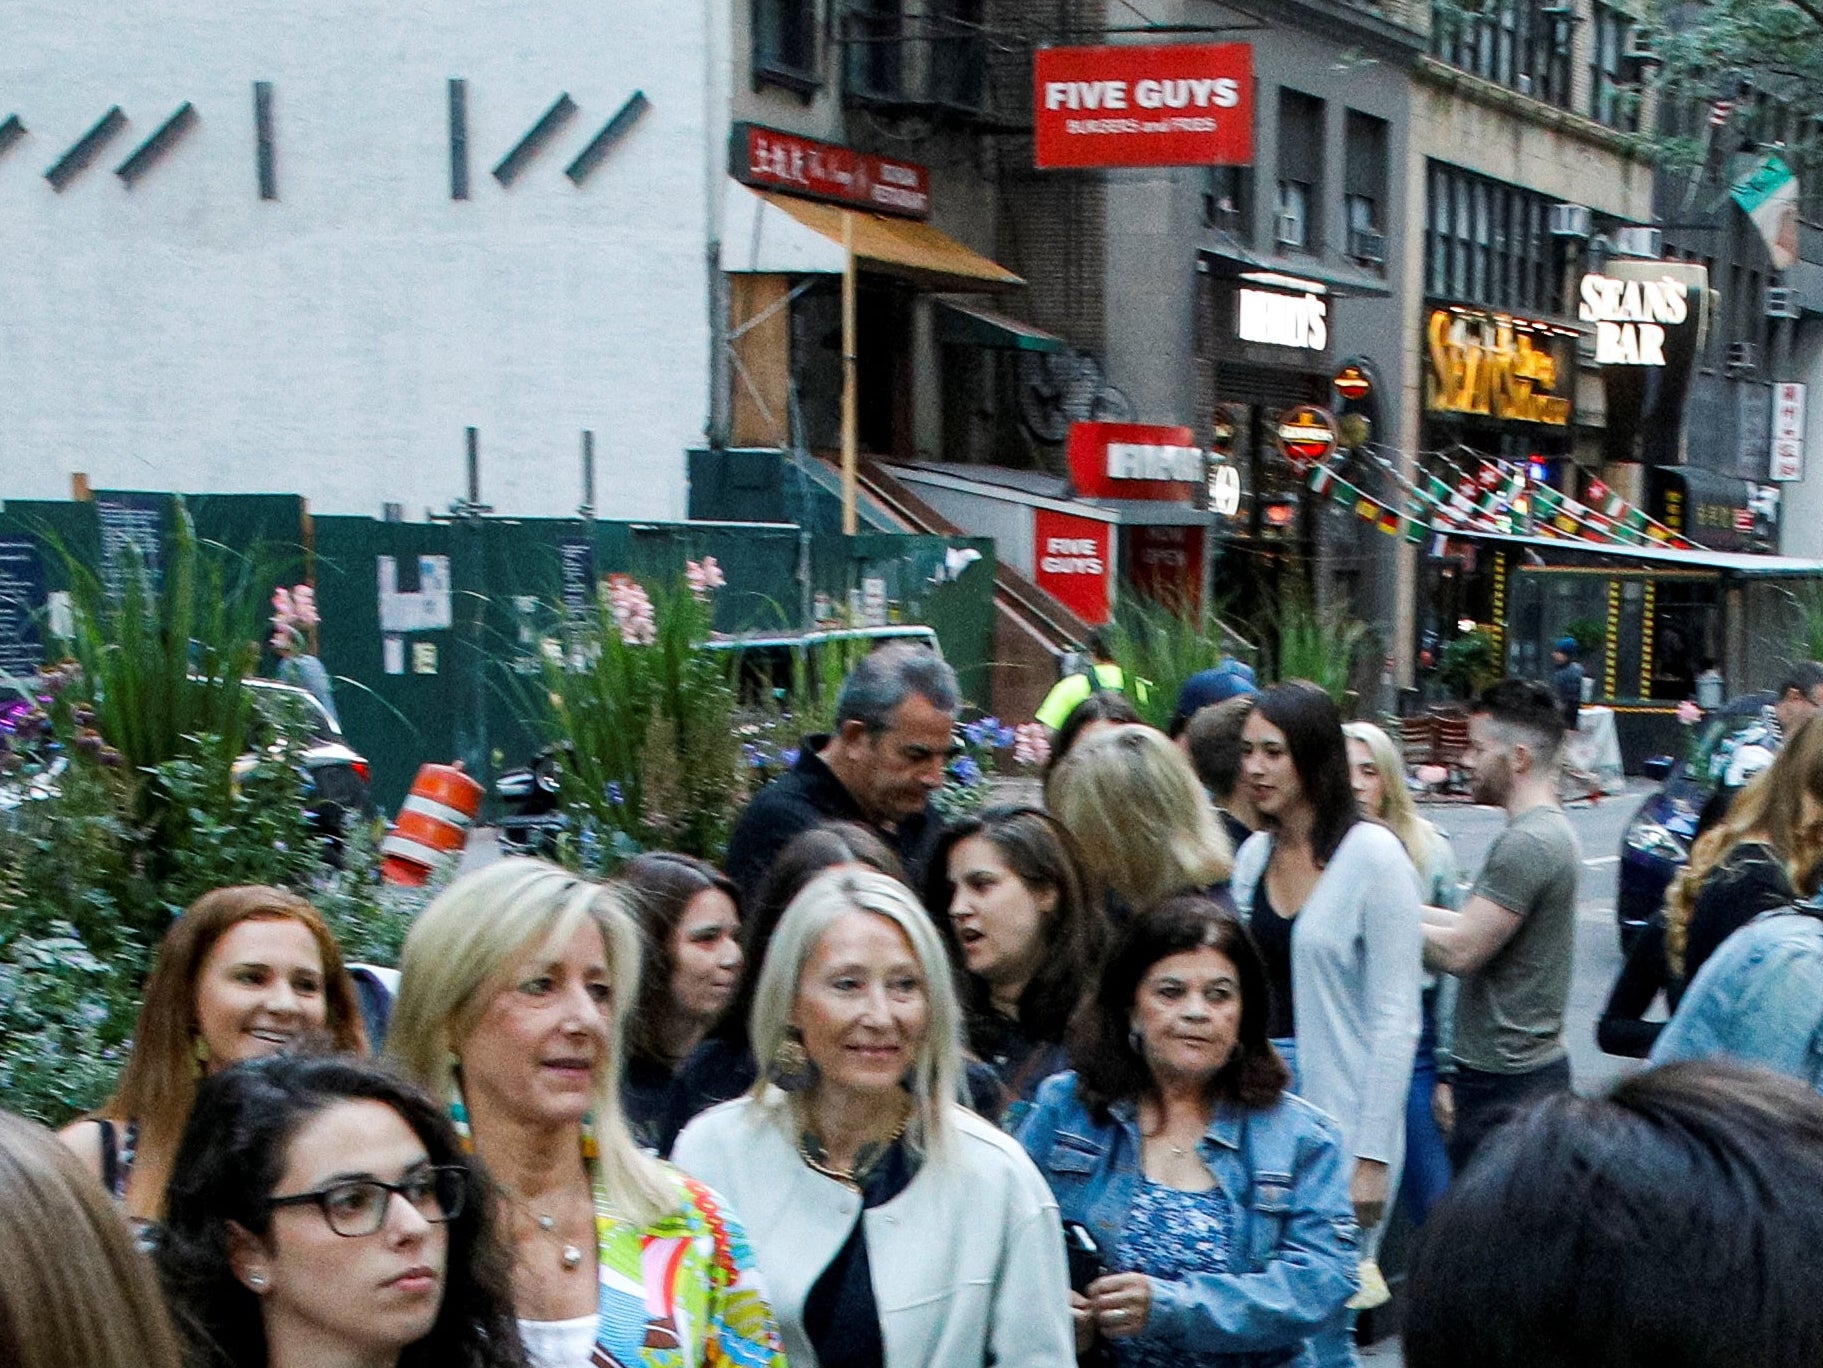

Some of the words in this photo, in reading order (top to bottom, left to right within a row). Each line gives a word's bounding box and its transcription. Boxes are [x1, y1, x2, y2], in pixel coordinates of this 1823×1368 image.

[1044, 81, 1128, 110] FIVE
[1134, 78, 1240, 109] GUYS
[1579, 273, 1688, 325] SEAN'S
[1594, 321, 1666, 366] BAR
[1046, 537, 1097, 556] FIVE
[1040, 556, 1104, 576] GUYS
